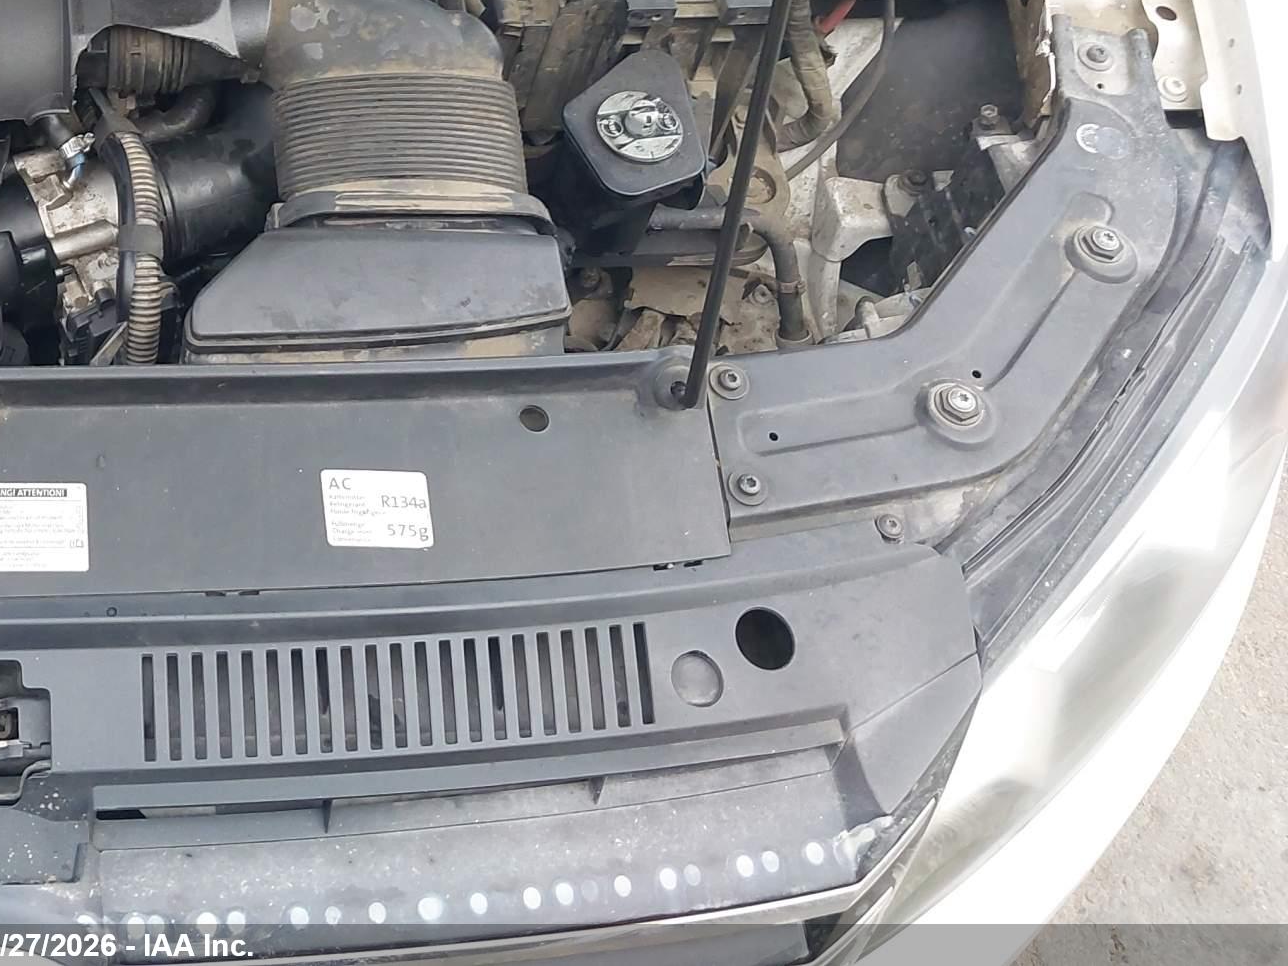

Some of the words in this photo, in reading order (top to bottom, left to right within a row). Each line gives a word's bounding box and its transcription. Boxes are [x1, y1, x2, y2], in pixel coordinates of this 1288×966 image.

[329, 477, 351, 490] AC
[18, 488, 65, 498] ATTENTION!
[381, 494, 427, 509] R134a
